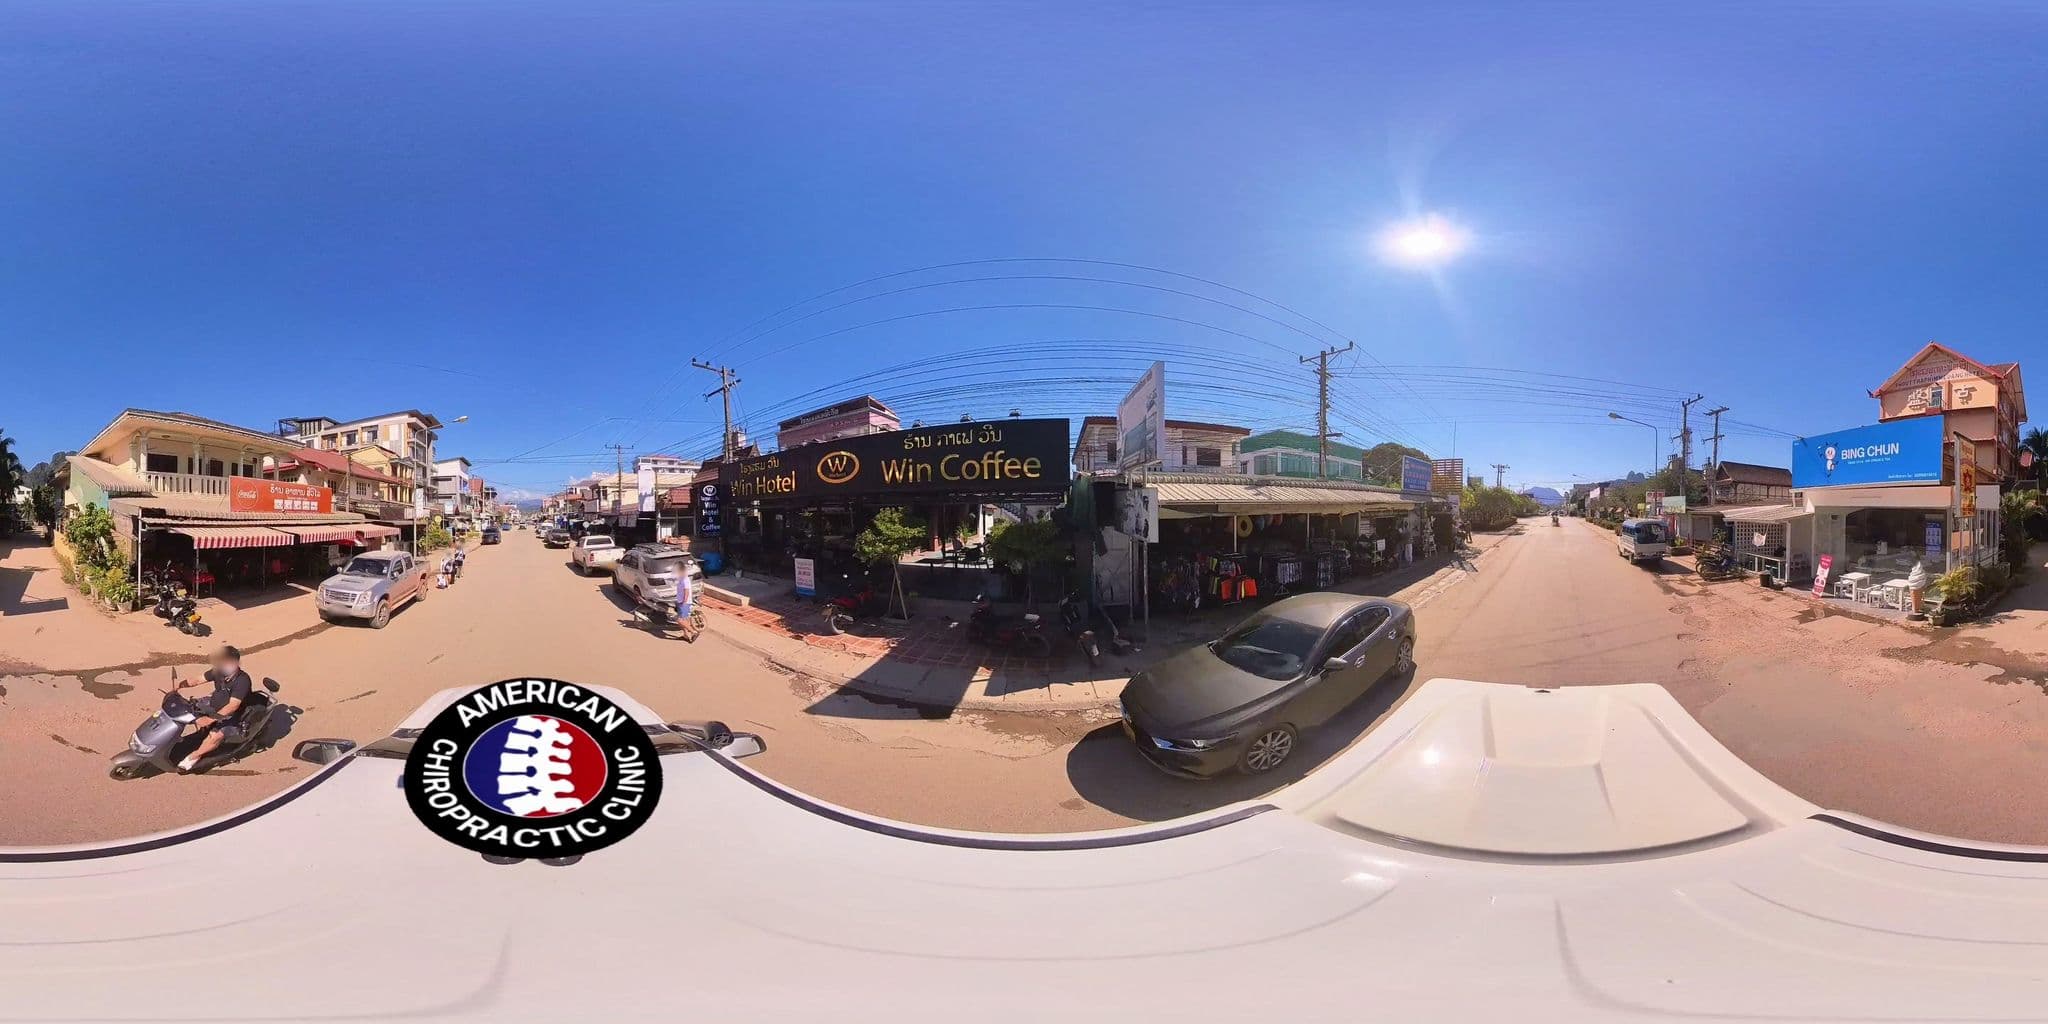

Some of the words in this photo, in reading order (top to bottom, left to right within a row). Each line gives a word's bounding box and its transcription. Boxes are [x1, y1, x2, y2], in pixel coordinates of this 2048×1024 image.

[1841, 447, 1865, 460] BING
[1866, 442, 1899, 457] CHUN
[880, 458, 932, 484] Win
[939, 450, 1042, 481] Coffee
[730, 478, 753, 497] Win
[756, 470, 796, 495] Hotel
